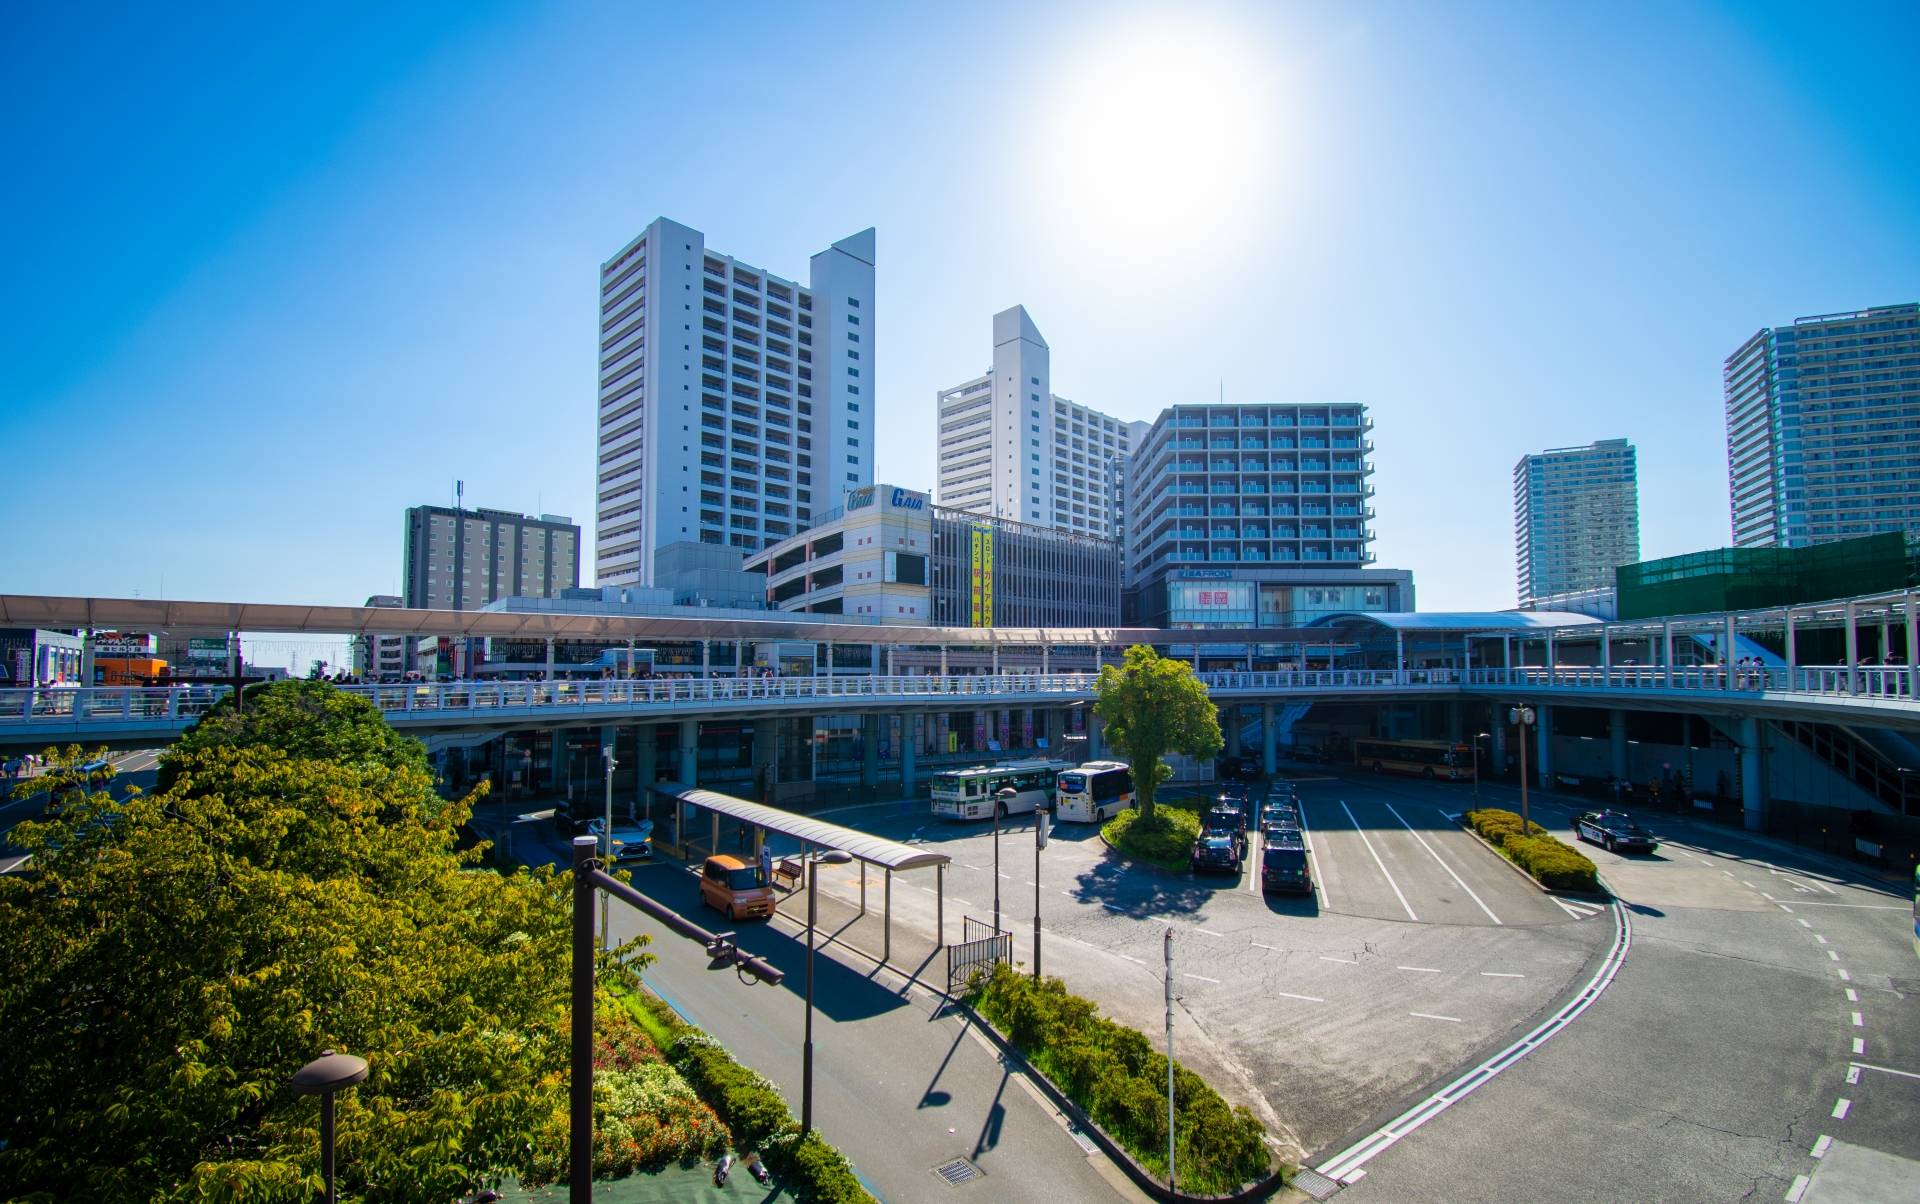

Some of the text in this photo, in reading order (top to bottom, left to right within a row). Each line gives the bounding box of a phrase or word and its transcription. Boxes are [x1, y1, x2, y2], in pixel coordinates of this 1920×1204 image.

[847, 490, 874, 511] GAIA
[891, 488, 923, 510] GAIA
[1202, 570, 1232, 578] FRONT
